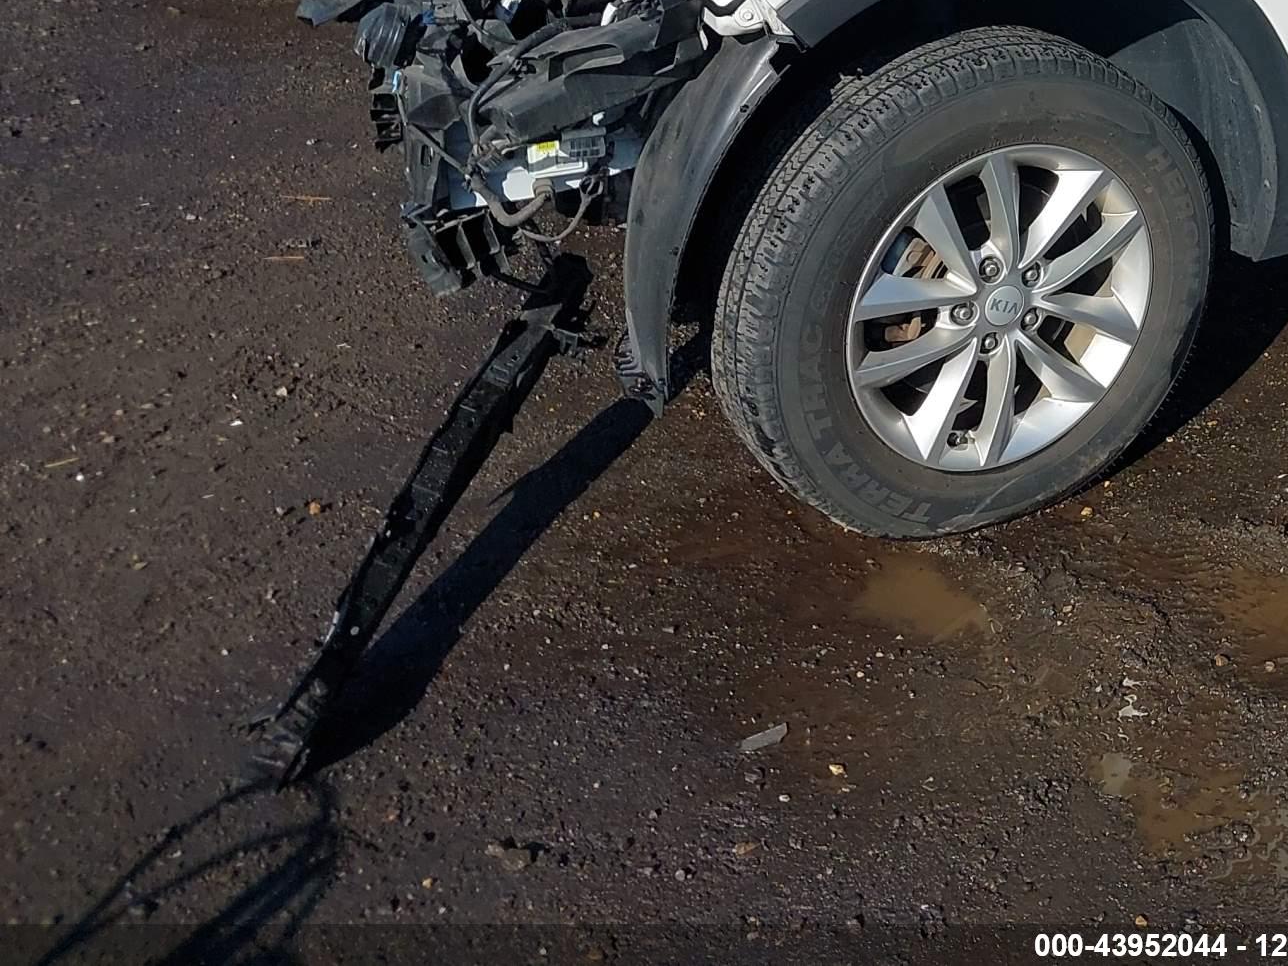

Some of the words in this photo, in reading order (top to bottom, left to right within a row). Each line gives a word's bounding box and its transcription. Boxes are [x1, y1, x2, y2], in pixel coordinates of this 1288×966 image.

[990, 297, 1018, 315] KIA
[798, 321, 834, 441] TRAC
[822, 440, 933, 524] TERRA
